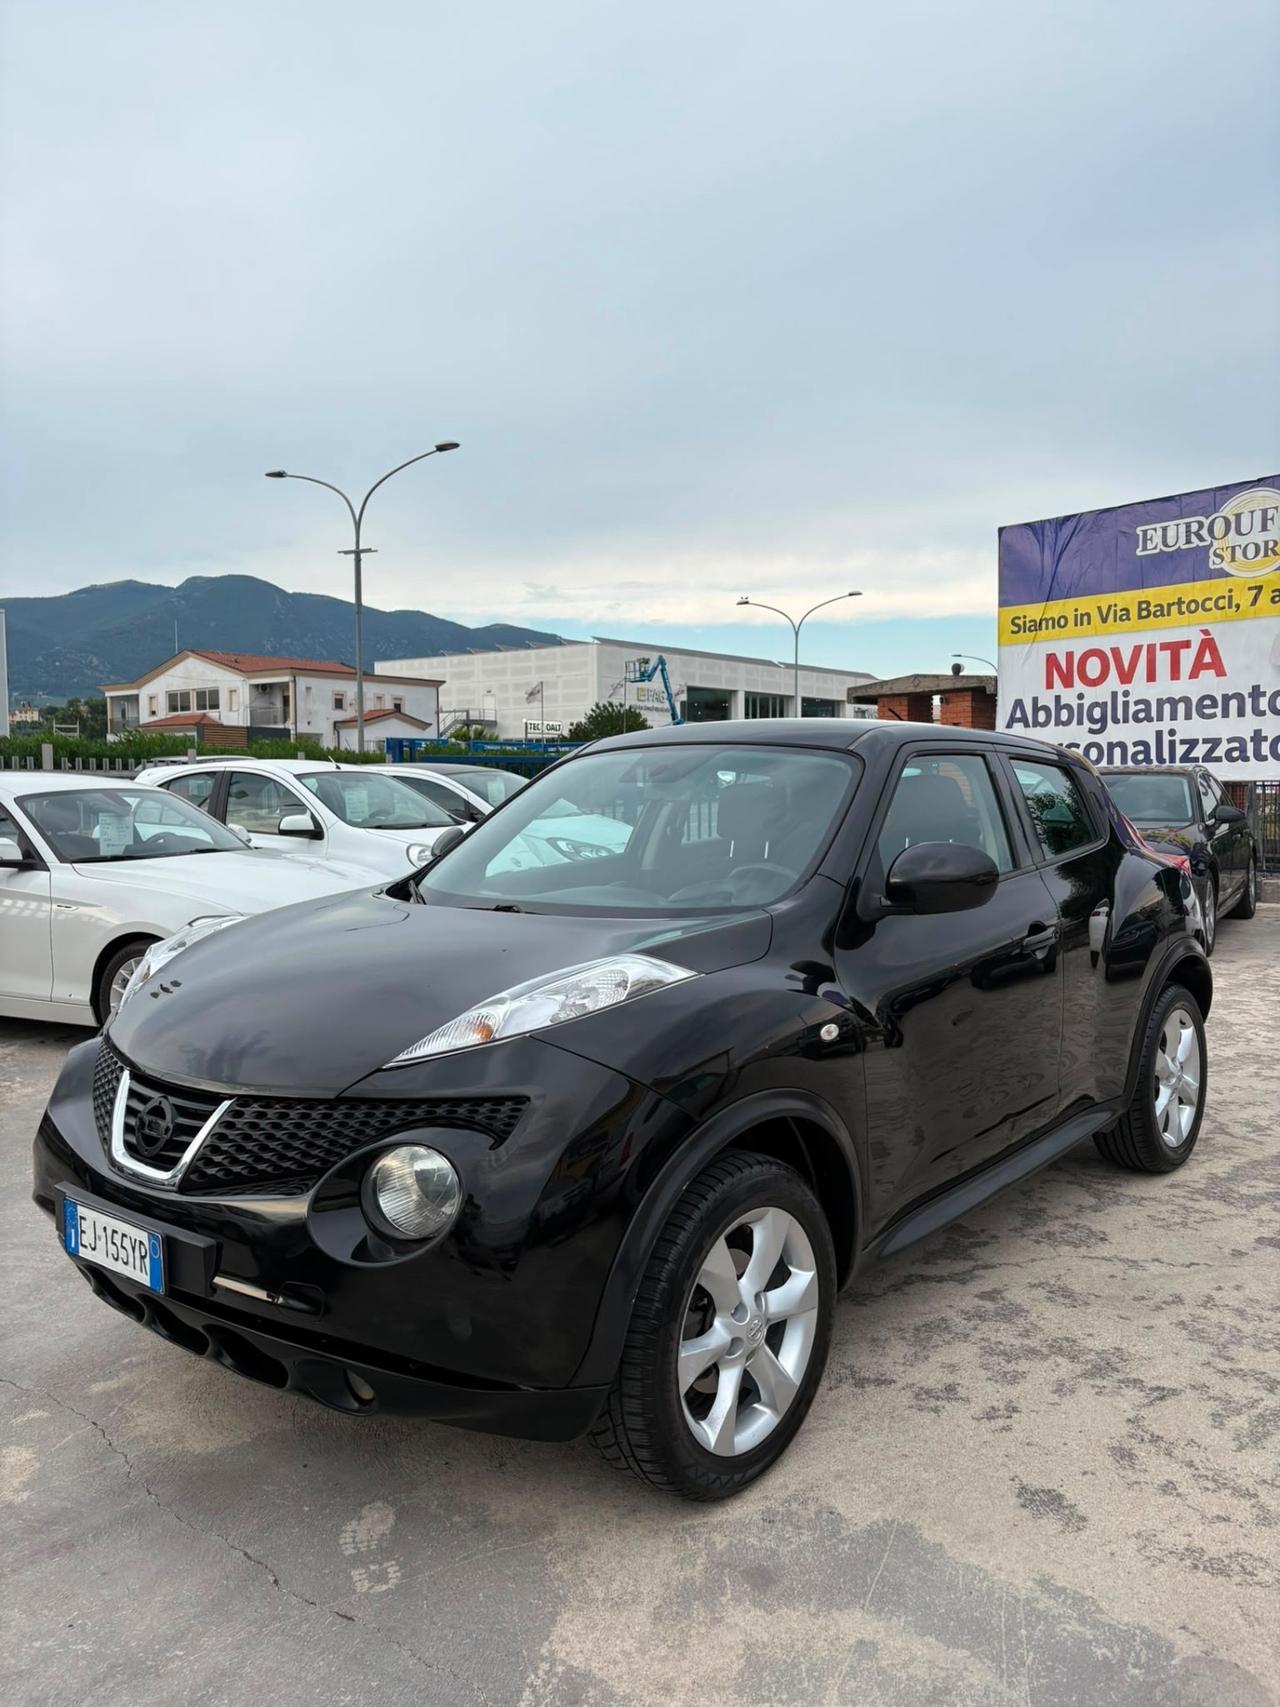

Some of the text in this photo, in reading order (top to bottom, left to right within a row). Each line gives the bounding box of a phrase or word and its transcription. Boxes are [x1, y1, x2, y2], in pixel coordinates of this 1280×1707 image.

[1212, 539, 1280, 566] STOR
[1010, 614, 1069, 635] Siamo
[1074, 608, 1092, 627] in
[1097, 603, 1131, 625] Via
[1137, 588, 1240, 619] Bartocci,
[1247, 585, 1263, 607] 7
[1045, 629, 1228, 690] NOVITÀ
[1005, 684, 1280, 735] Abbigliamento
